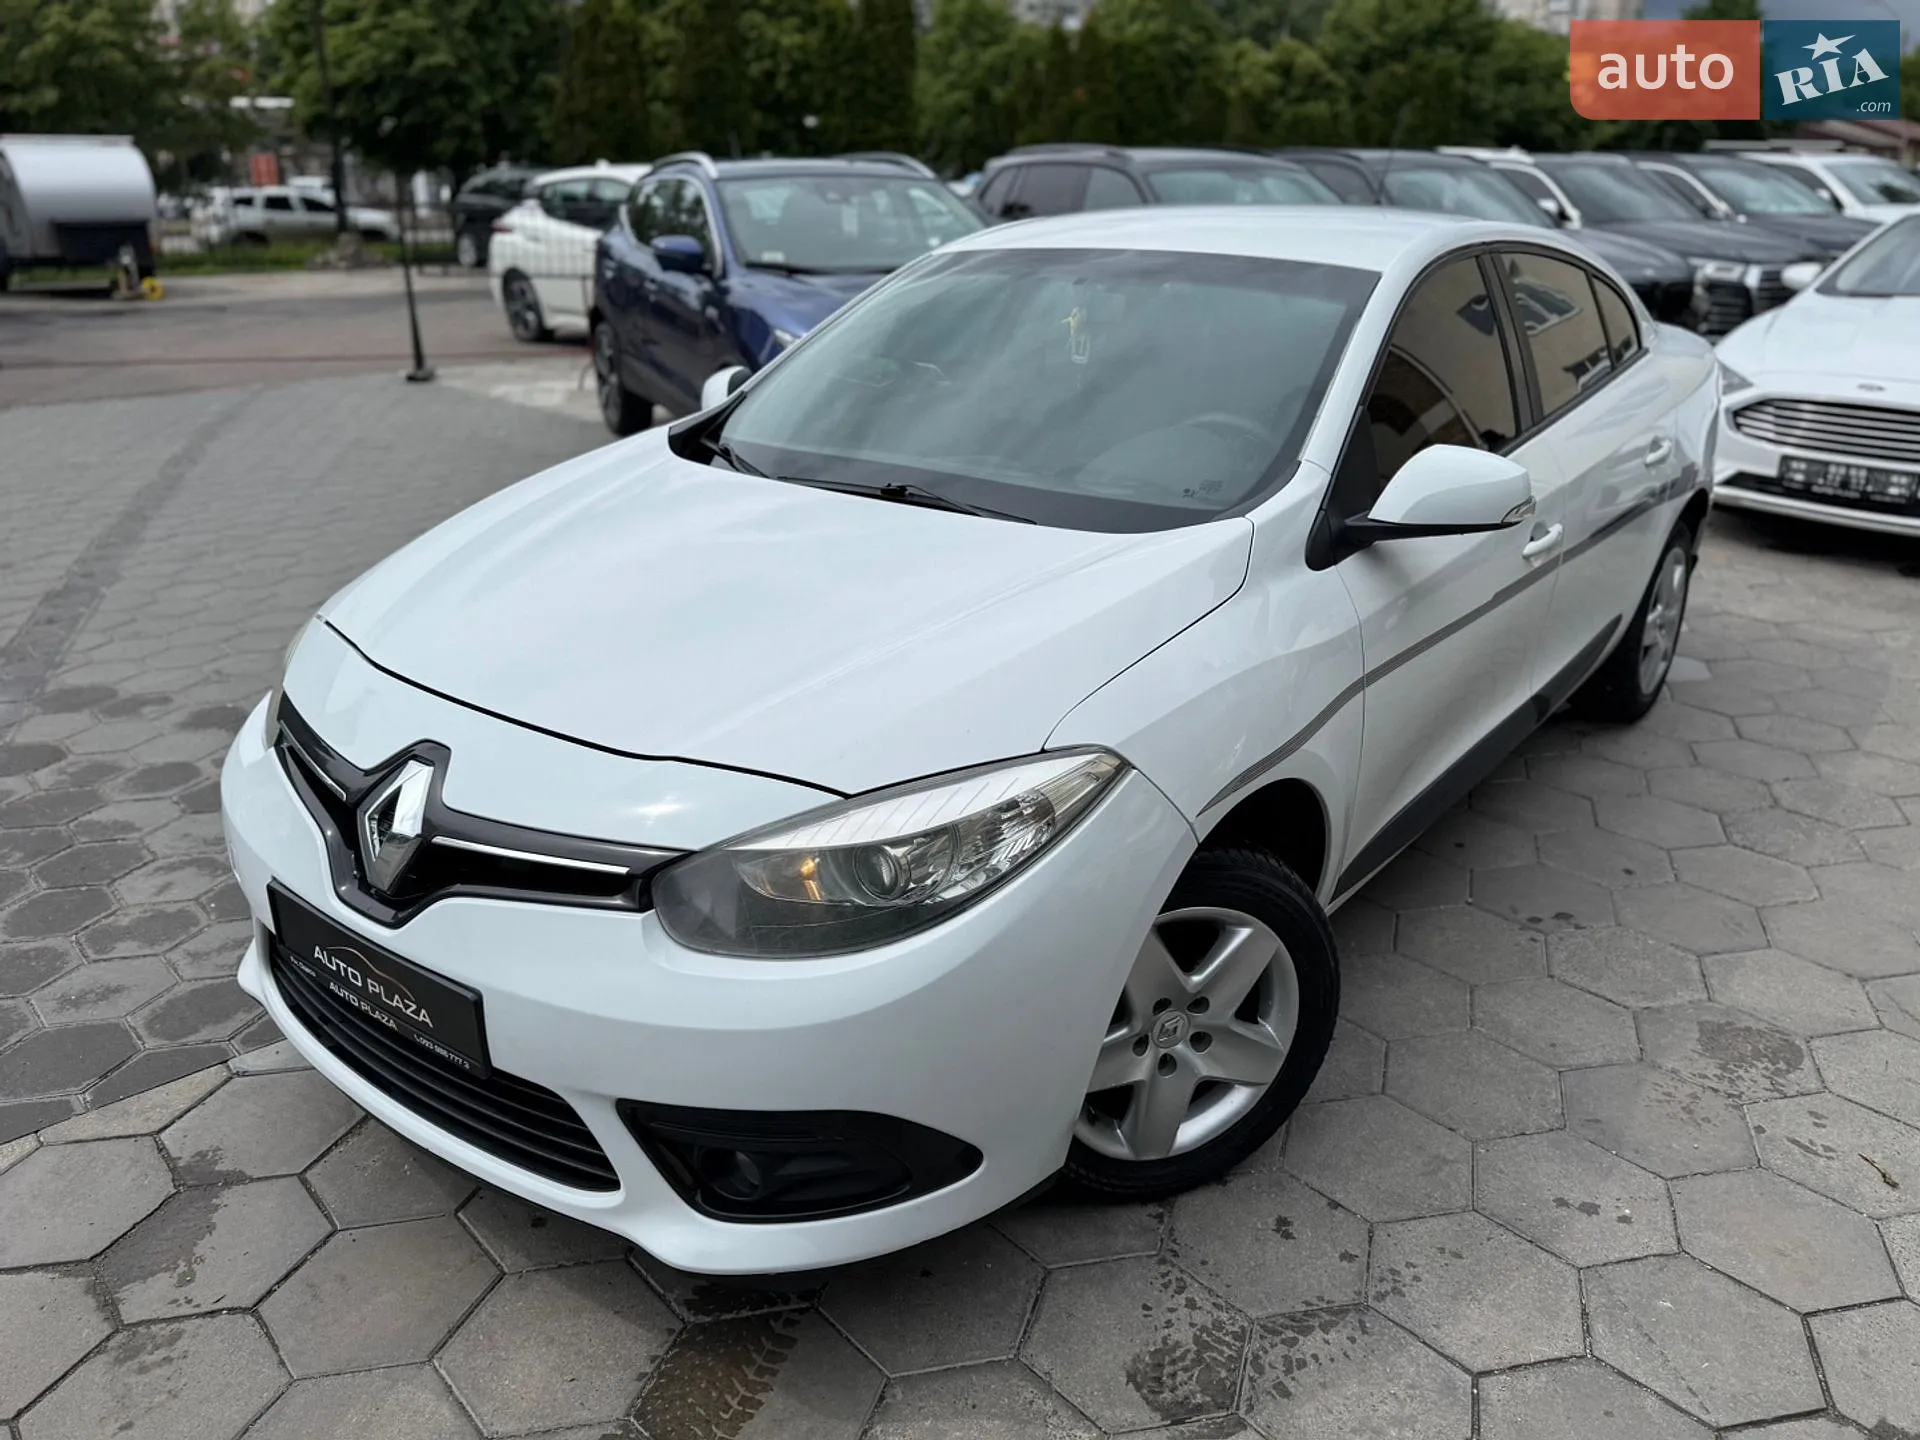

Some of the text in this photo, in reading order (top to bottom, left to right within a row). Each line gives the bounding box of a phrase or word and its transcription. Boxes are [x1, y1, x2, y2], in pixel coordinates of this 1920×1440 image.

[314, 945, 363, 987] AUTO
[366, 978, 433, 1028] PLAZA
[329, 982, 399, 1032] AUTO PLAZA
